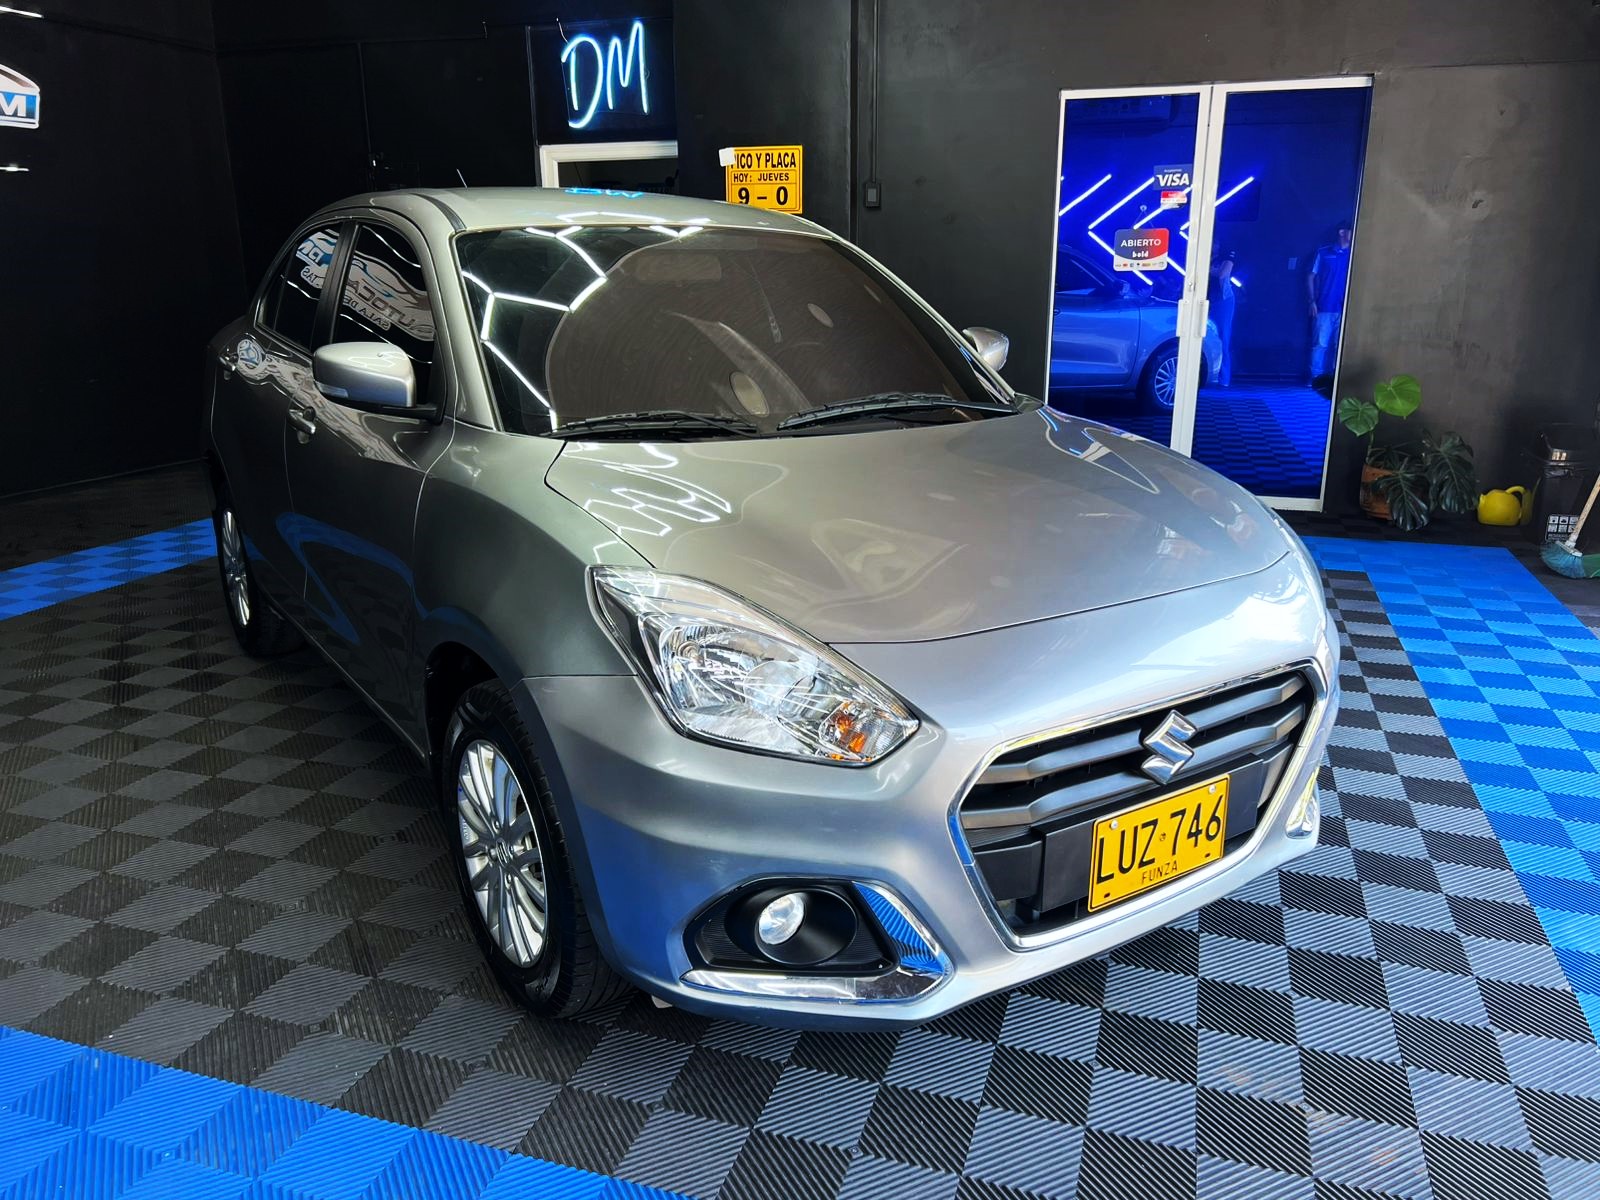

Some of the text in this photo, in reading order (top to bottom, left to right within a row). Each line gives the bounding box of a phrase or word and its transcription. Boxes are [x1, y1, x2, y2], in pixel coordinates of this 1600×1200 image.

[561, 20, 648, 129] DM
[755, 153, 762, 169] Y
[765, 152, 797, 168] PLACA
[733, 172, 790, 182] HOY: JUEVES
[1155, 173, 1190, 187] VISA
[738, 187, 750, 205] 9
[776, 186, 789, 206] 0
[1120, 238, 1162, 247] ABIERTO
[1096, 795, 1224, 884] LUZ 746
[1141, 860, 1179, 884] FUNZA
